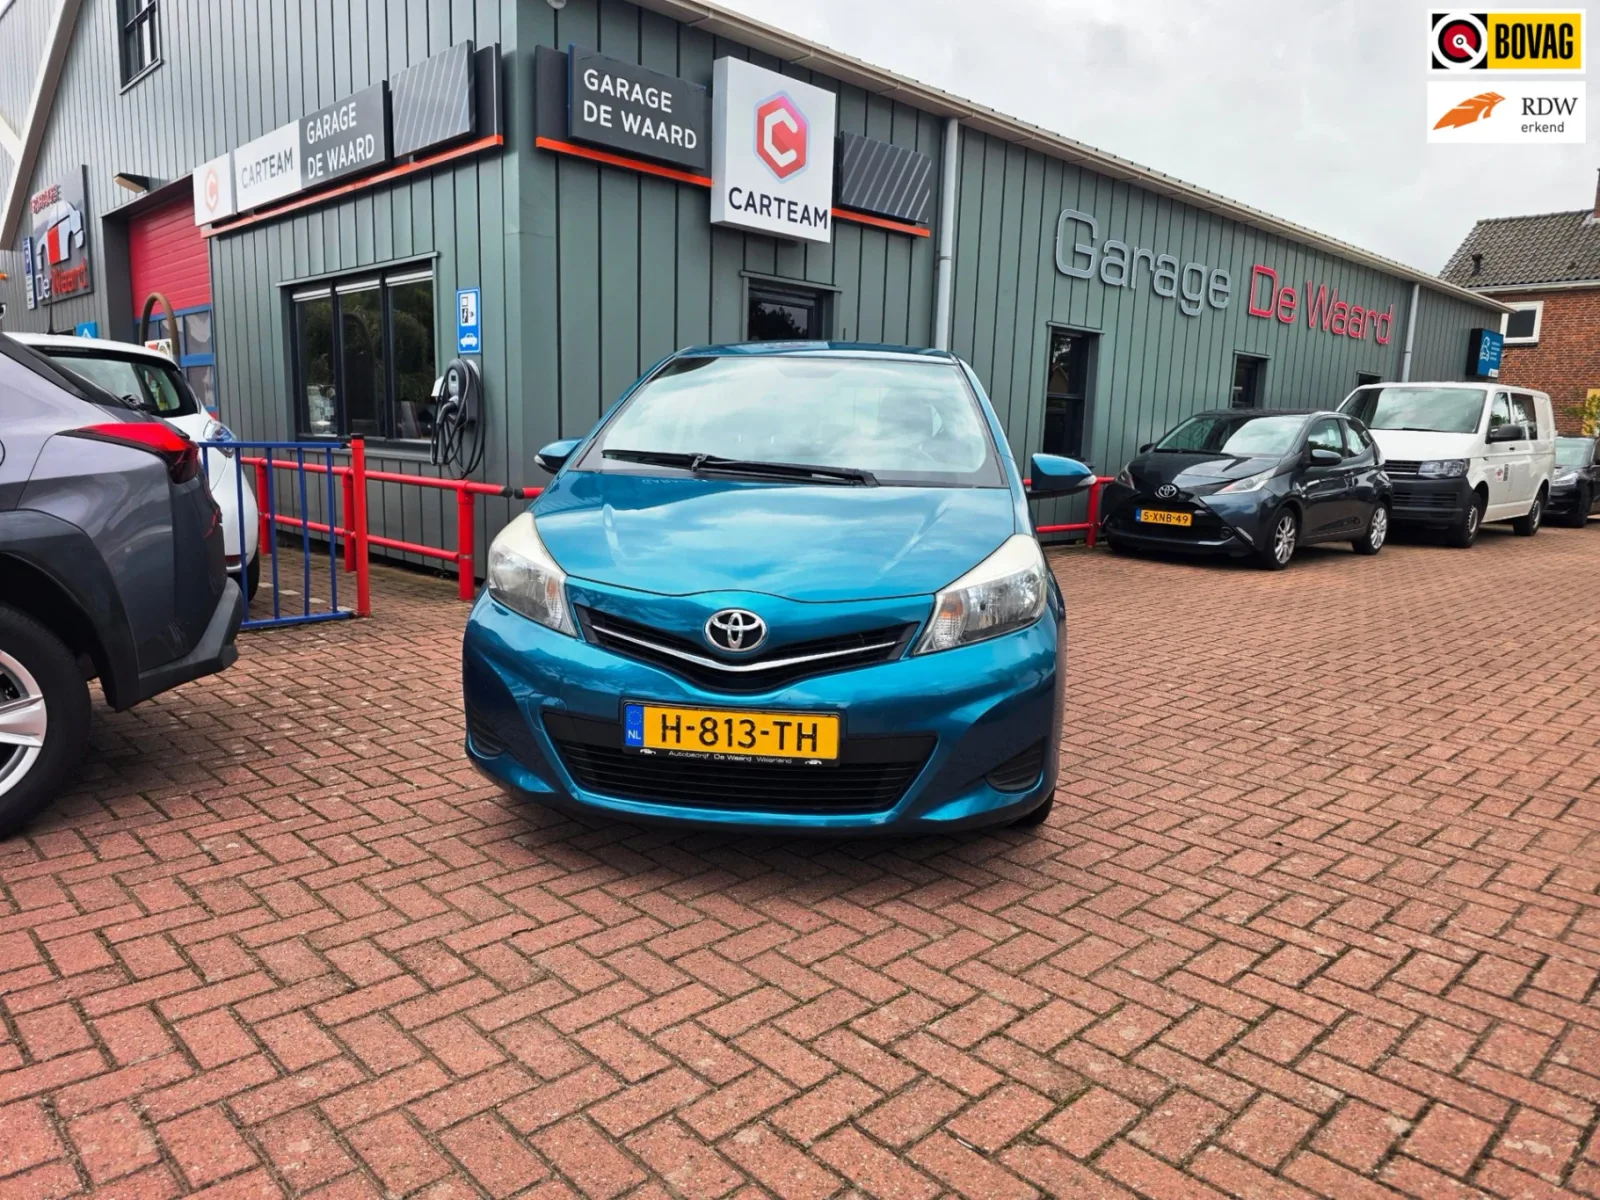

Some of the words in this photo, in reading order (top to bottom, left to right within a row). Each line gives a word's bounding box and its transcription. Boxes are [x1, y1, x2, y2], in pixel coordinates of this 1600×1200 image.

[583, 68, 672, 113] GARAGE
[306, 101, 358, 145] GARAGE
[583, 100, 613, 128] DE
[621, 111, 697, 149] WAARD
[241, 147, 294, 189] CARTEAM
[307, 152, 324, 180] DE
[326, 133, 375, 172] WAARD
[728, 186, 828, 230] CARTEAM
[36, 273, 51, 301] De
[1055, 208, 1232, 317] Garage
[1249, 263, 1297, 324] De
[1306, 280, 1394, 345] Waard
[1143, 511, 1189, 524] 5-XNB-49
[627, 729, 641, 740] NL
[661, 713, 818, 752] H-813-TH
[713, 753, 725, 761] De
